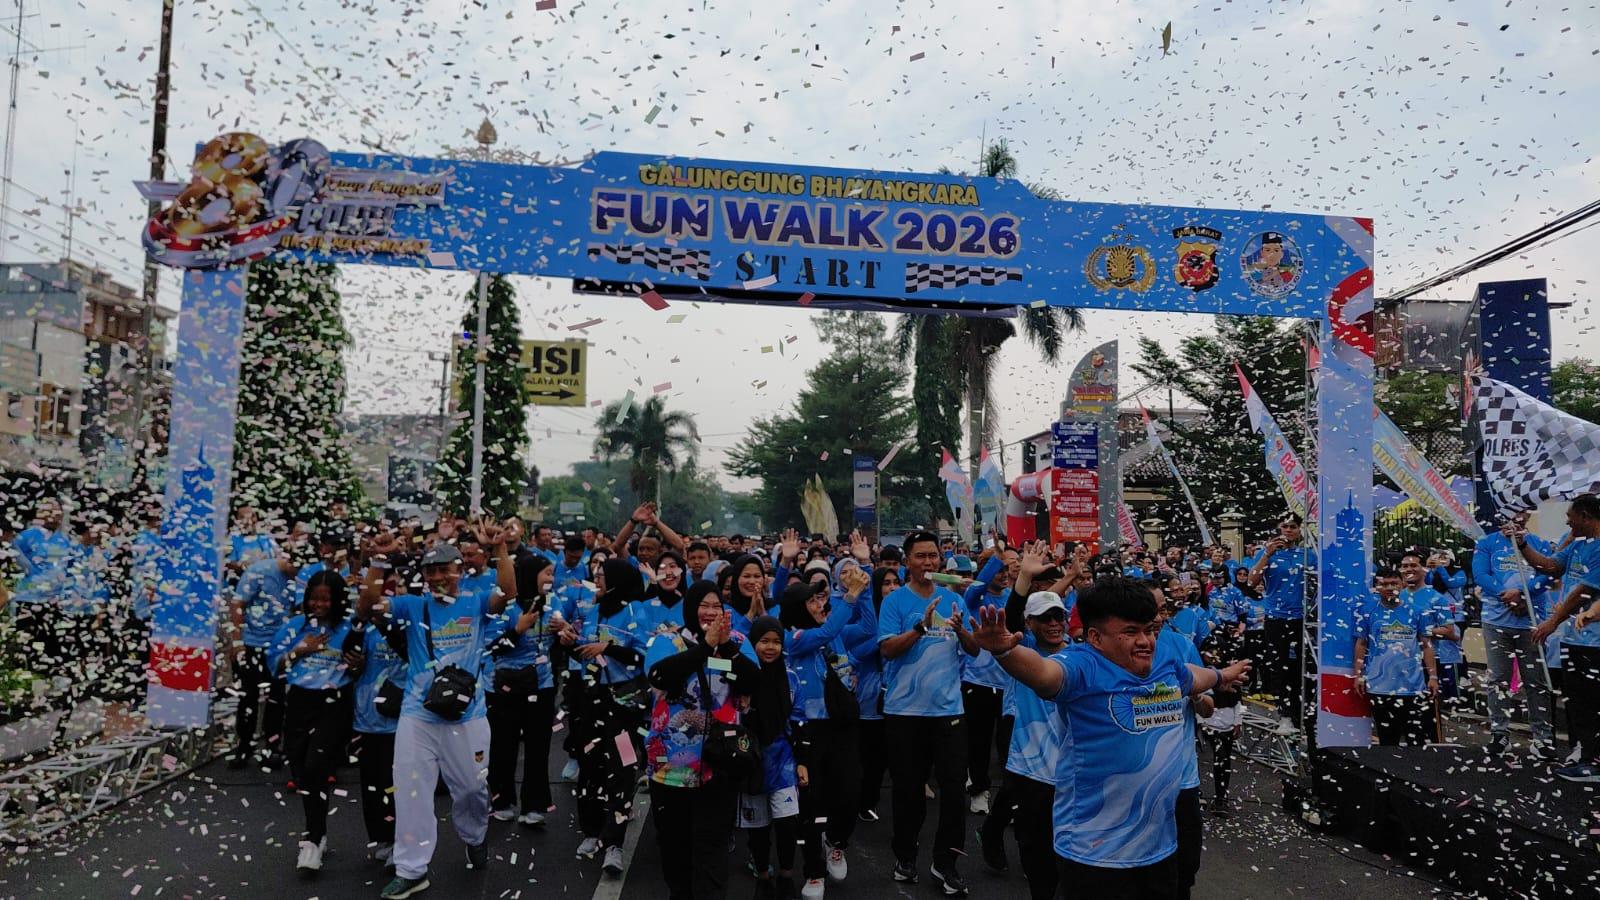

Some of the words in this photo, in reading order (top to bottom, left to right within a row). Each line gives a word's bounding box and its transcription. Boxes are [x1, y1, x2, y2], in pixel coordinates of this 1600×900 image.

[639, 163, 805, 195] GALUNGGUNG
[810, 175, 980, 207] BHAYANGKARA
[594, 189, 712, 240] FUN
[721, 197, 887, 251] WALK
[894, 208, 1020, 258] 2026
[735, 251, 882, 289] START
[1136, 717, 1152, 727] FUN
[1154, 714, 1177, 724] WALK
